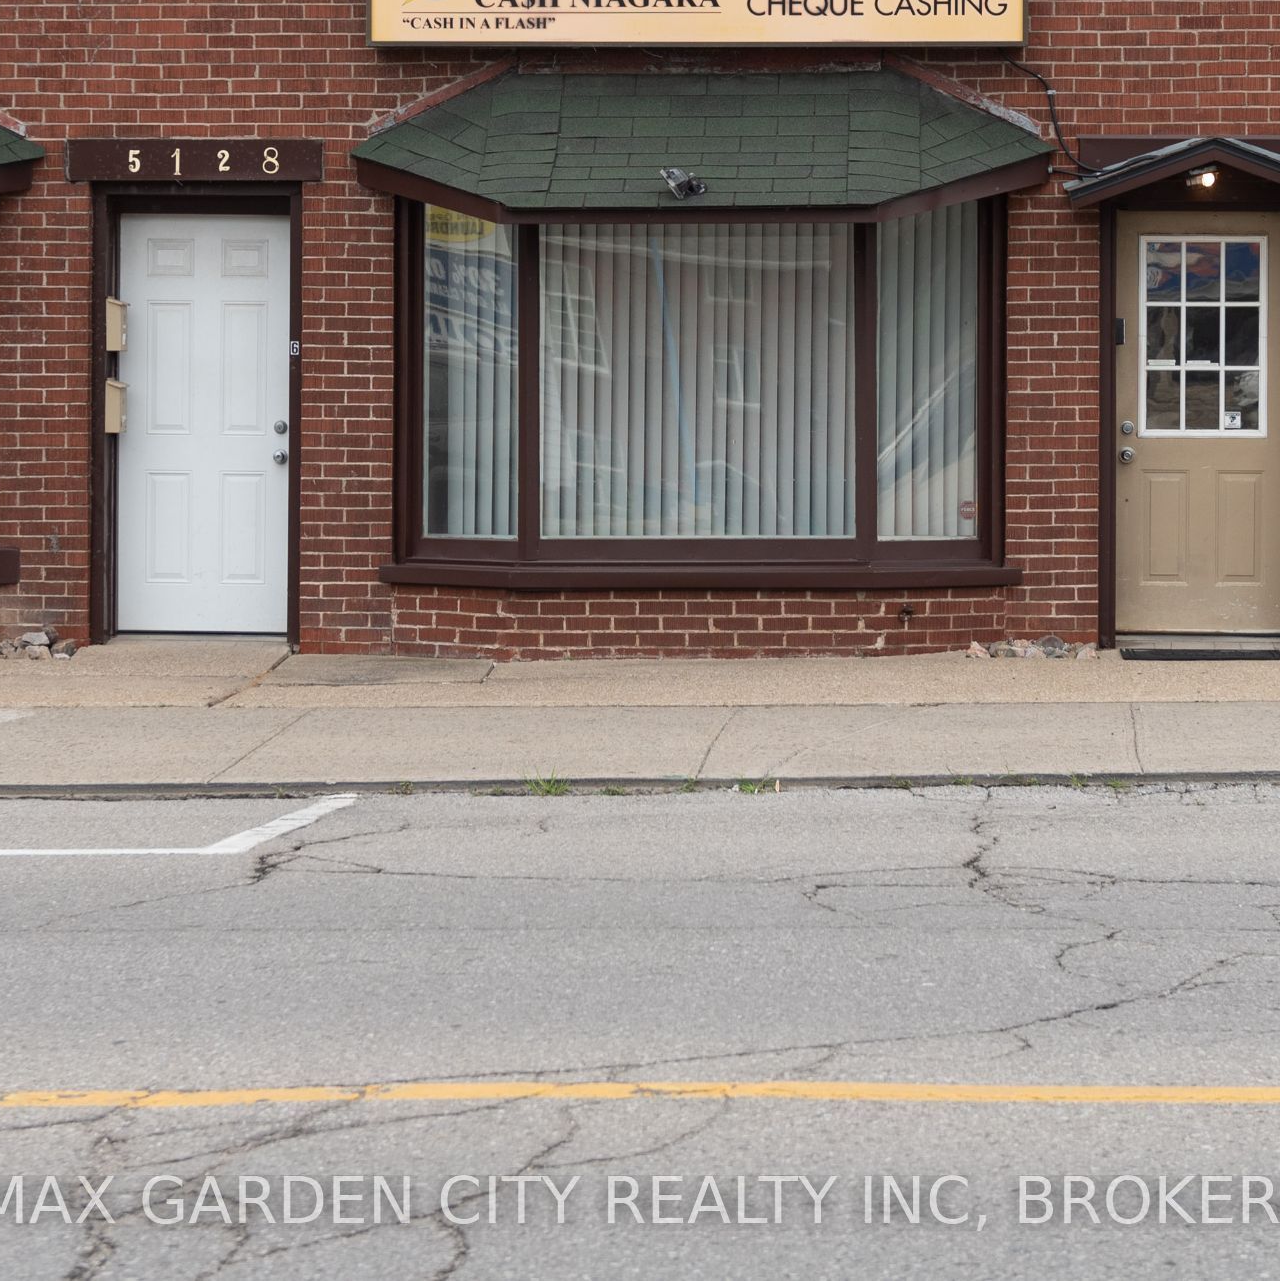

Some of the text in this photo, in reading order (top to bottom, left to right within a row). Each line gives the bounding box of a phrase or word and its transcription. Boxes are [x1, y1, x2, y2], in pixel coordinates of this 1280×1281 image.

[459, 17, 476, 29] IN
[480, 18, 490, 29] A
[291, 341, 299, 354] 6
